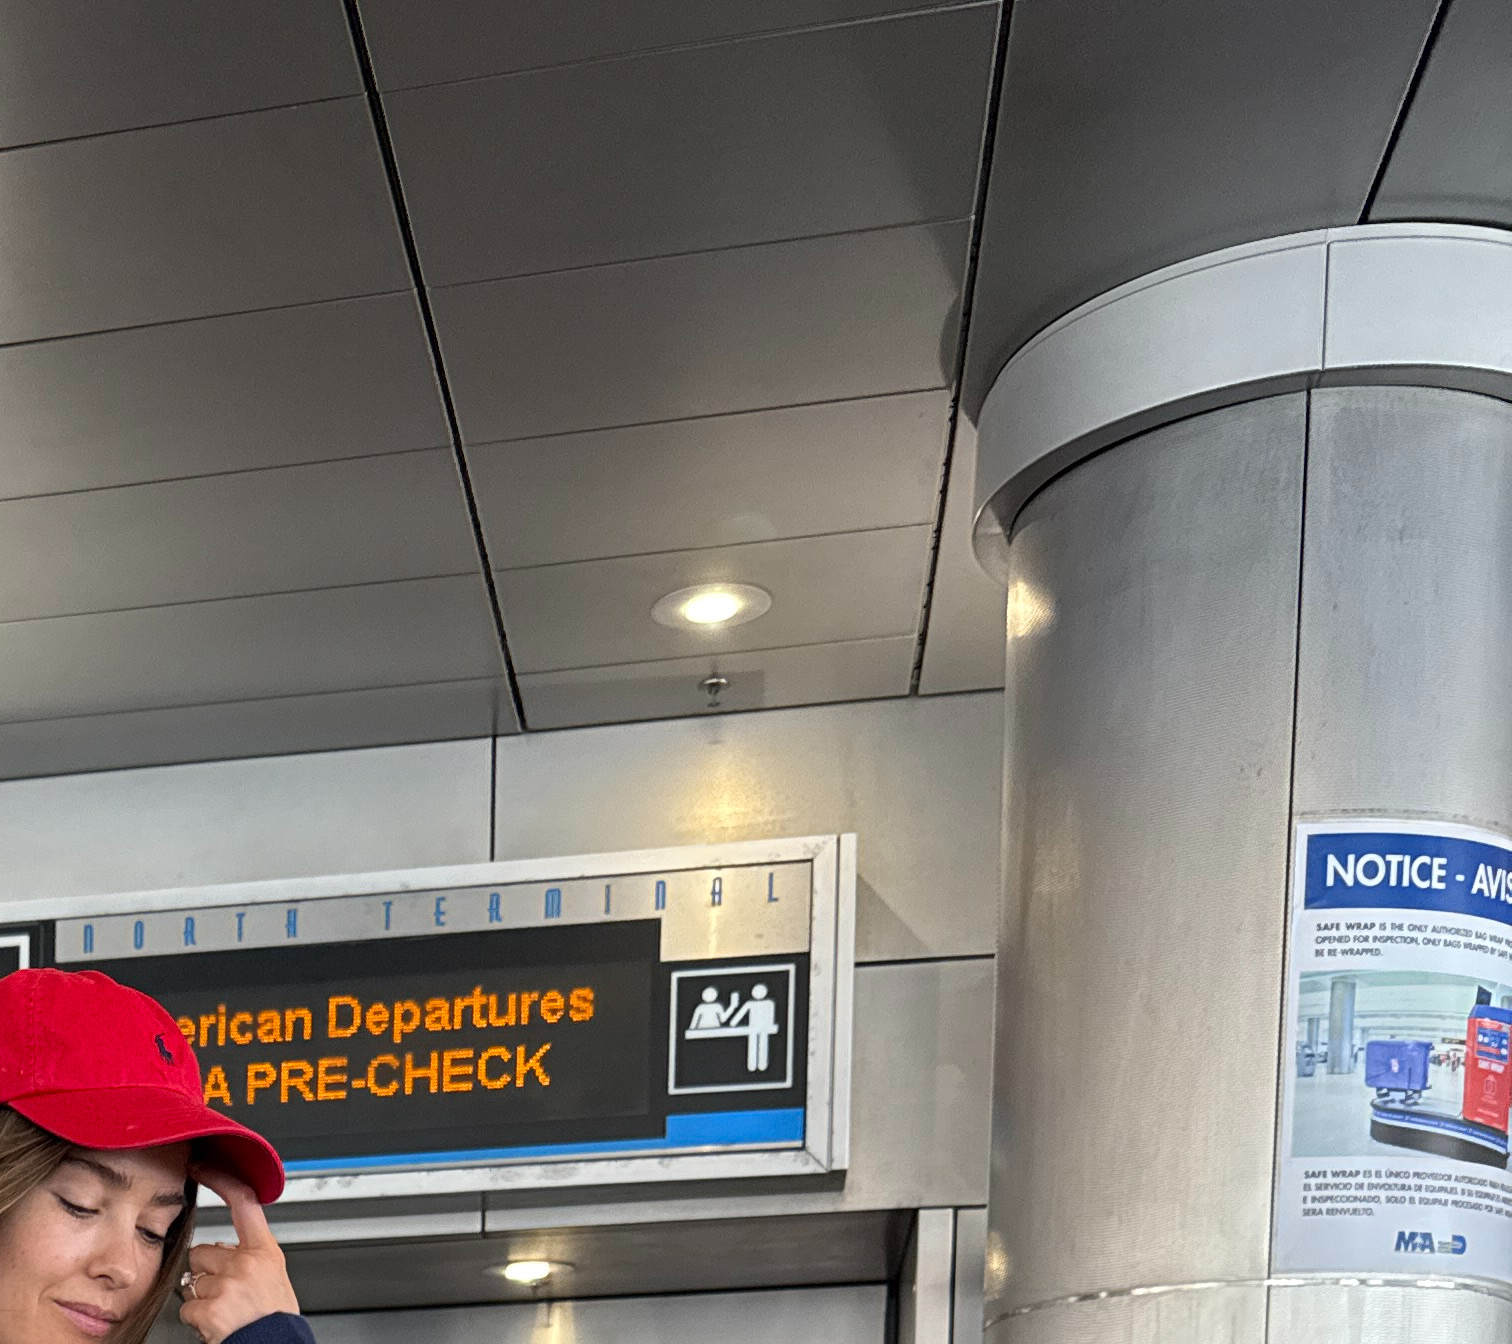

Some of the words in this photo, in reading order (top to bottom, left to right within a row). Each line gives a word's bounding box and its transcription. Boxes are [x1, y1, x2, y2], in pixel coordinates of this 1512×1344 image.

[1326, 854, 1447, 889] NOTICE
[84, 908, 297, 954] NORTH
[383, 872, 780, 931] TERMINAL
[1316, 922, 1340, 931] SAFE
[1345, 922, 1376, 931] WRAP
[1379, 922, 1387, 931] IS
[1390, 923, 1404, 932] THE
[1407, 923, 1428, 933] ONLY
[1315, 935, 1351, 945] OPENED
[1353, 935, 1370, 944] FOR
[1372, 935, 1420, 946] INSPECTION,
[1422, 936, 1442, 946] ONLY
[1443, 938, 1462, 949] BAGS
[1315, 948, 1325, 957] BE
[328, 985, 596, 1044] Departures
[247, 1041, 552, 1105] PRE-CHECK
[1304, 1170, 1327, 1179] SAFE
[1331, 1170, 1361, 1178] WRAP
[1363, 1170, 1373, 1179] ES
[1315, 1183, 1352, 1191] SERVICIO
[1354, 1182, 1365, 1191] DE
[1414, 1183, 1423, 1192] DE
